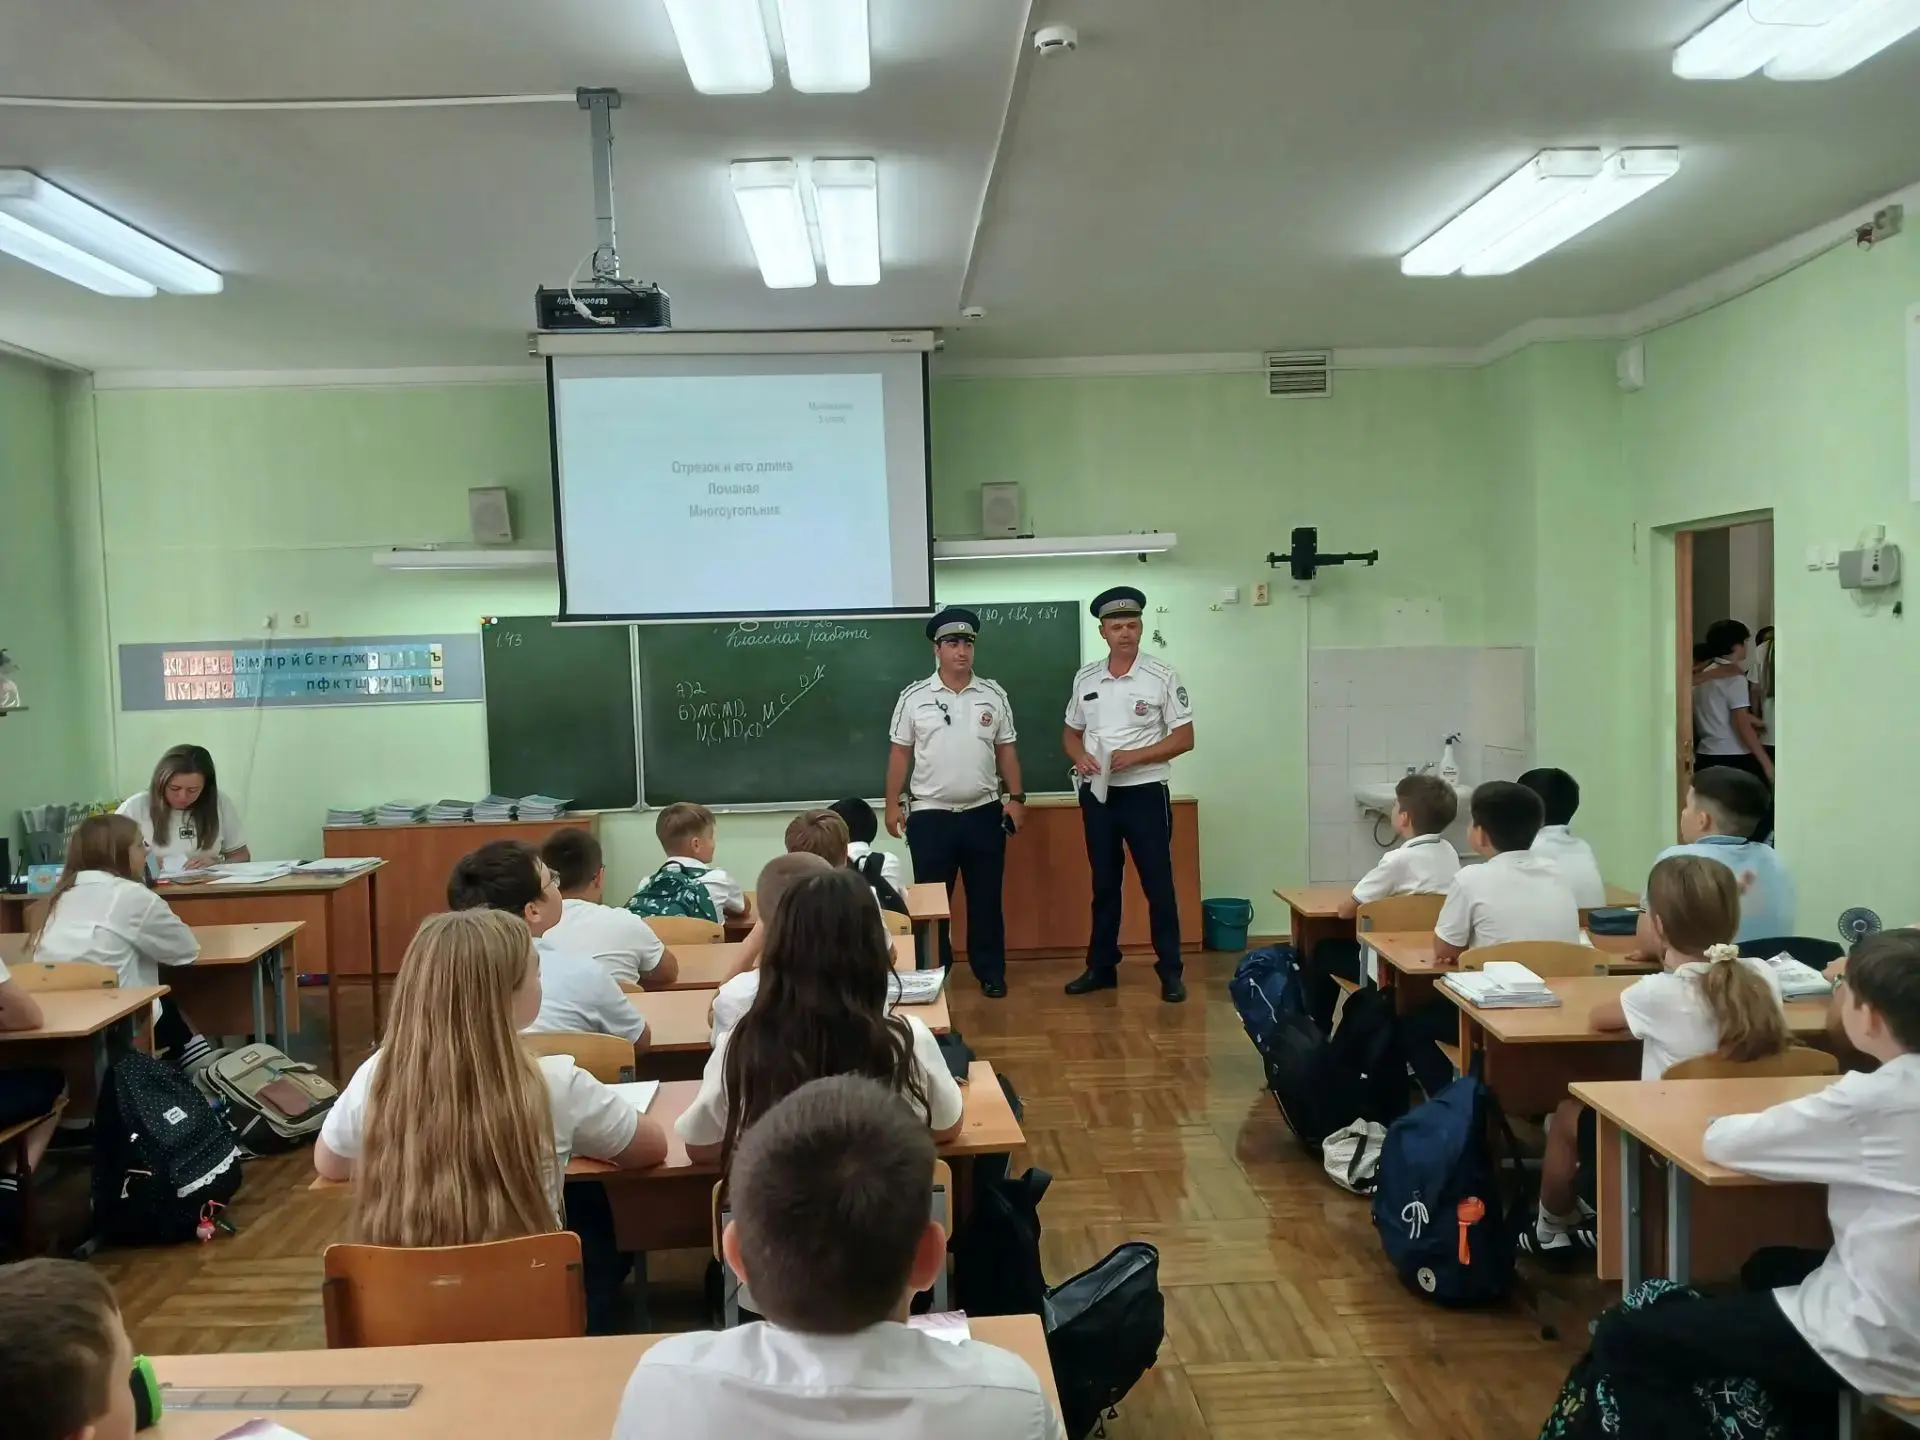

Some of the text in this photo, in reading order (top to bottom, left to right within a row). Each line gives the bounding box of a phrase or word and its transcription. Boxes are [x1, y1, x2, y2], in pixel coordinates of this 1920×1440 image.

[733, 462, 754, 473] его
[726, 625, 874, 650] Классная работа
